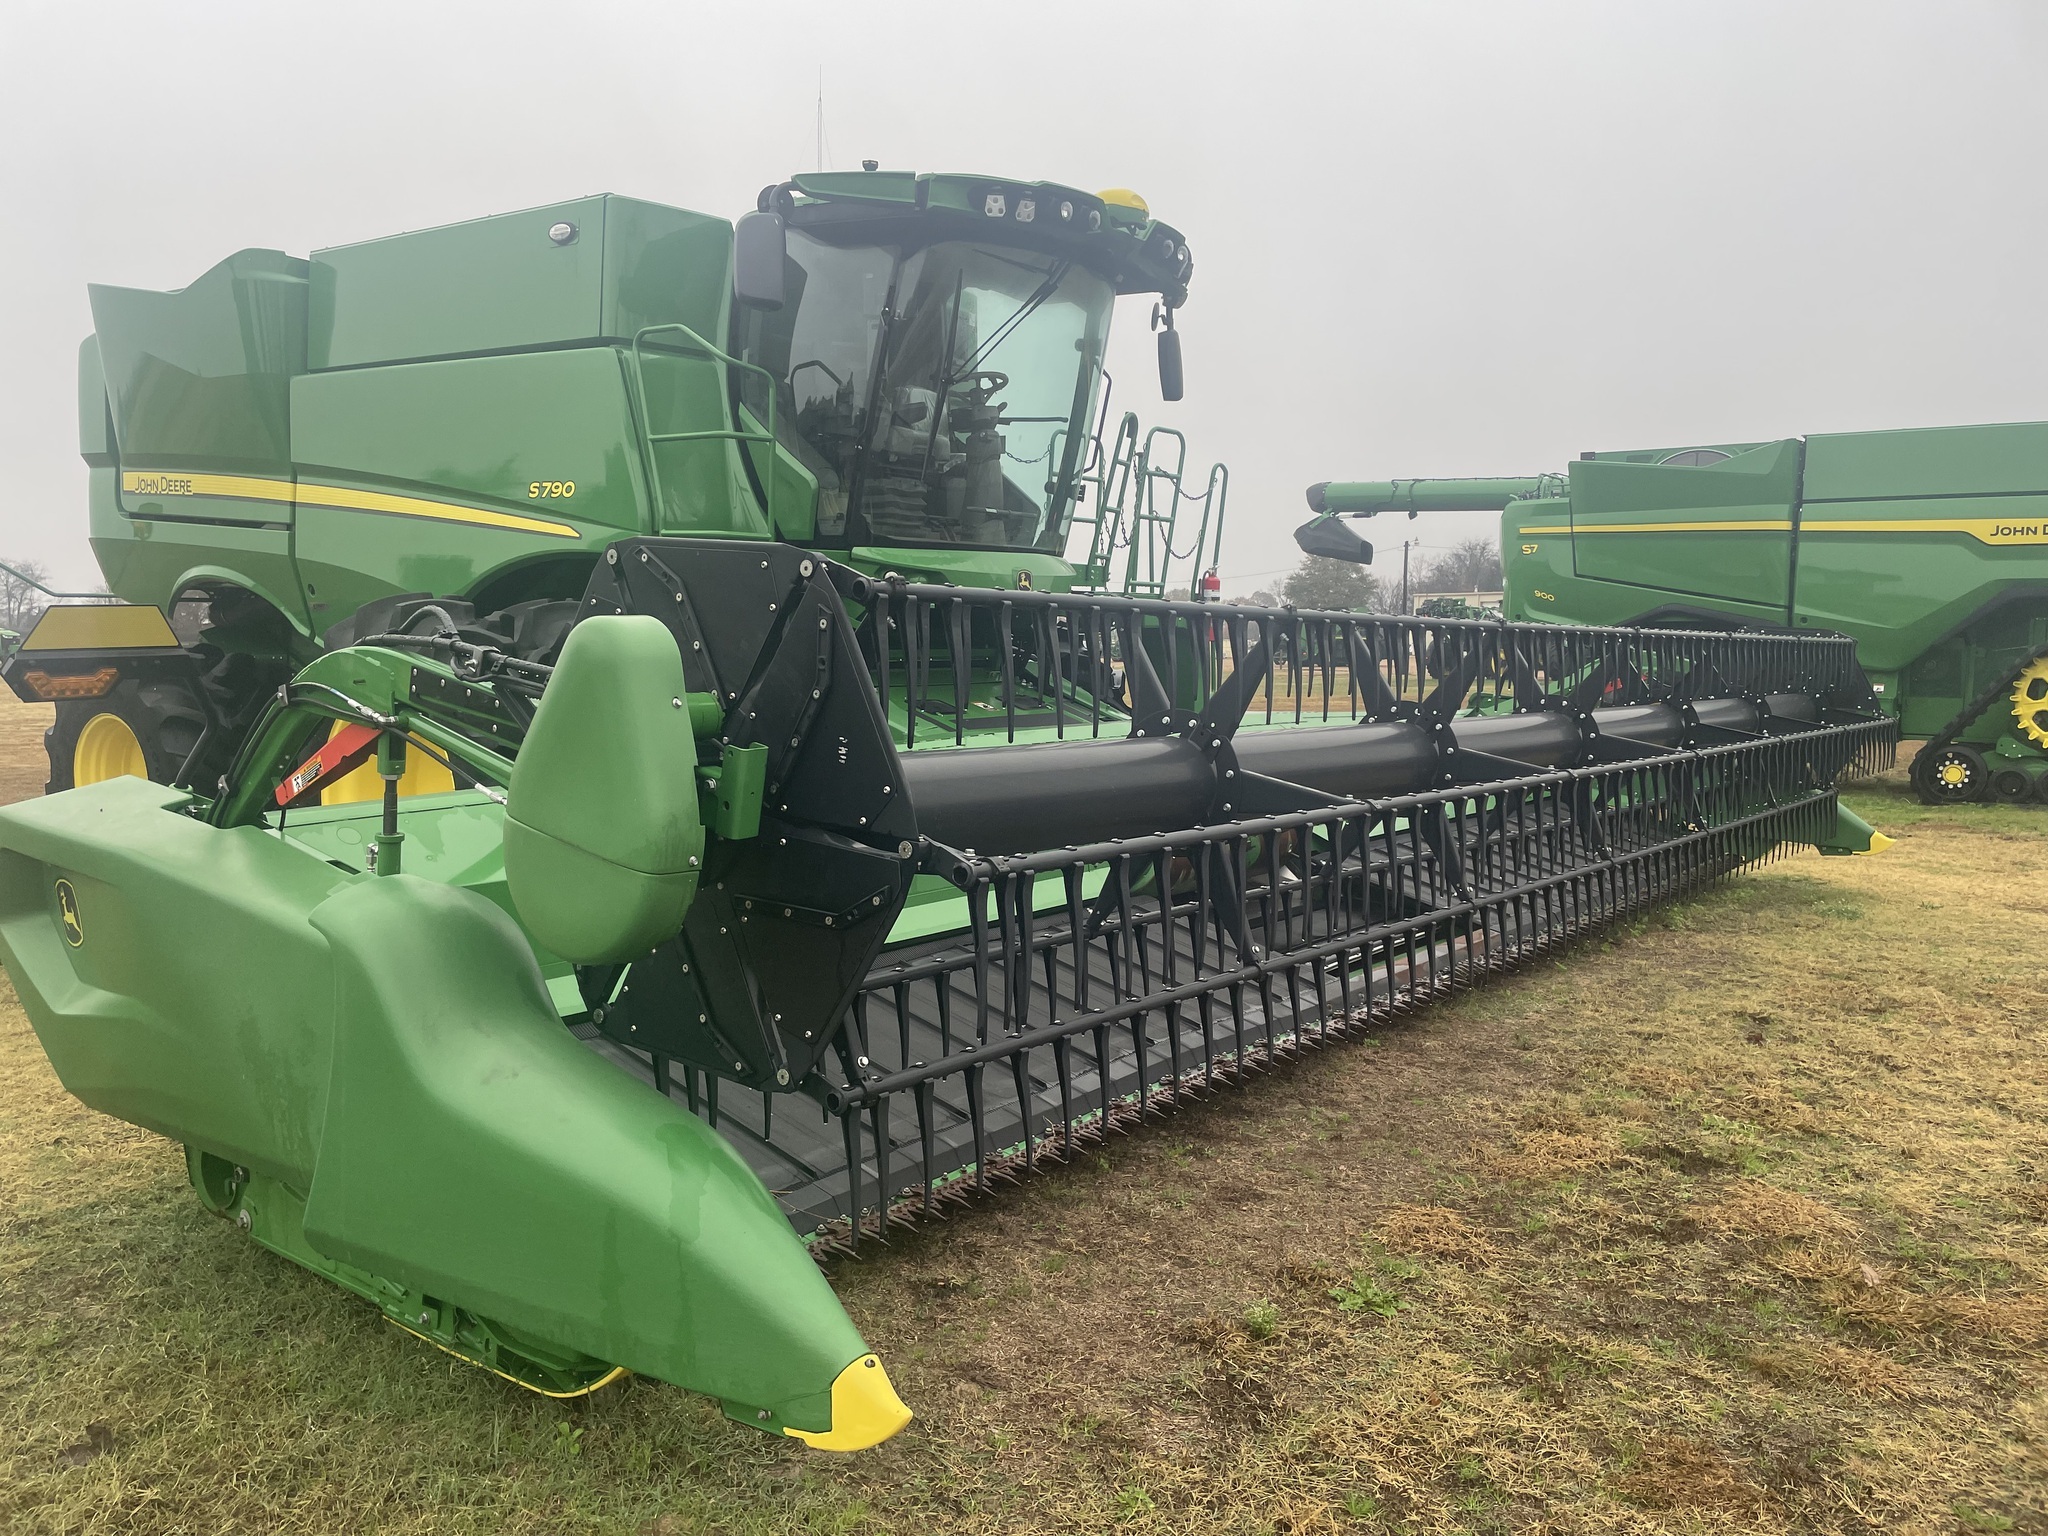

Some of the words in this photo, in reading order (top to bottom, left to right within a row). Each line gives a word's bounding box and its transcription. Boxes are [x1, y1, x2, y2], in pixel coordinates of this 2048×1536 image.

[135, 476, 159, 492] JOHN
[160, 476, 192, 493] DEERE
[528, 480, 576, 499] S790
[1990, 525, 2038, 537] JOHN
[1521, 544, 1539, 555] S7
[1534, 589, 1555, 602] 900
